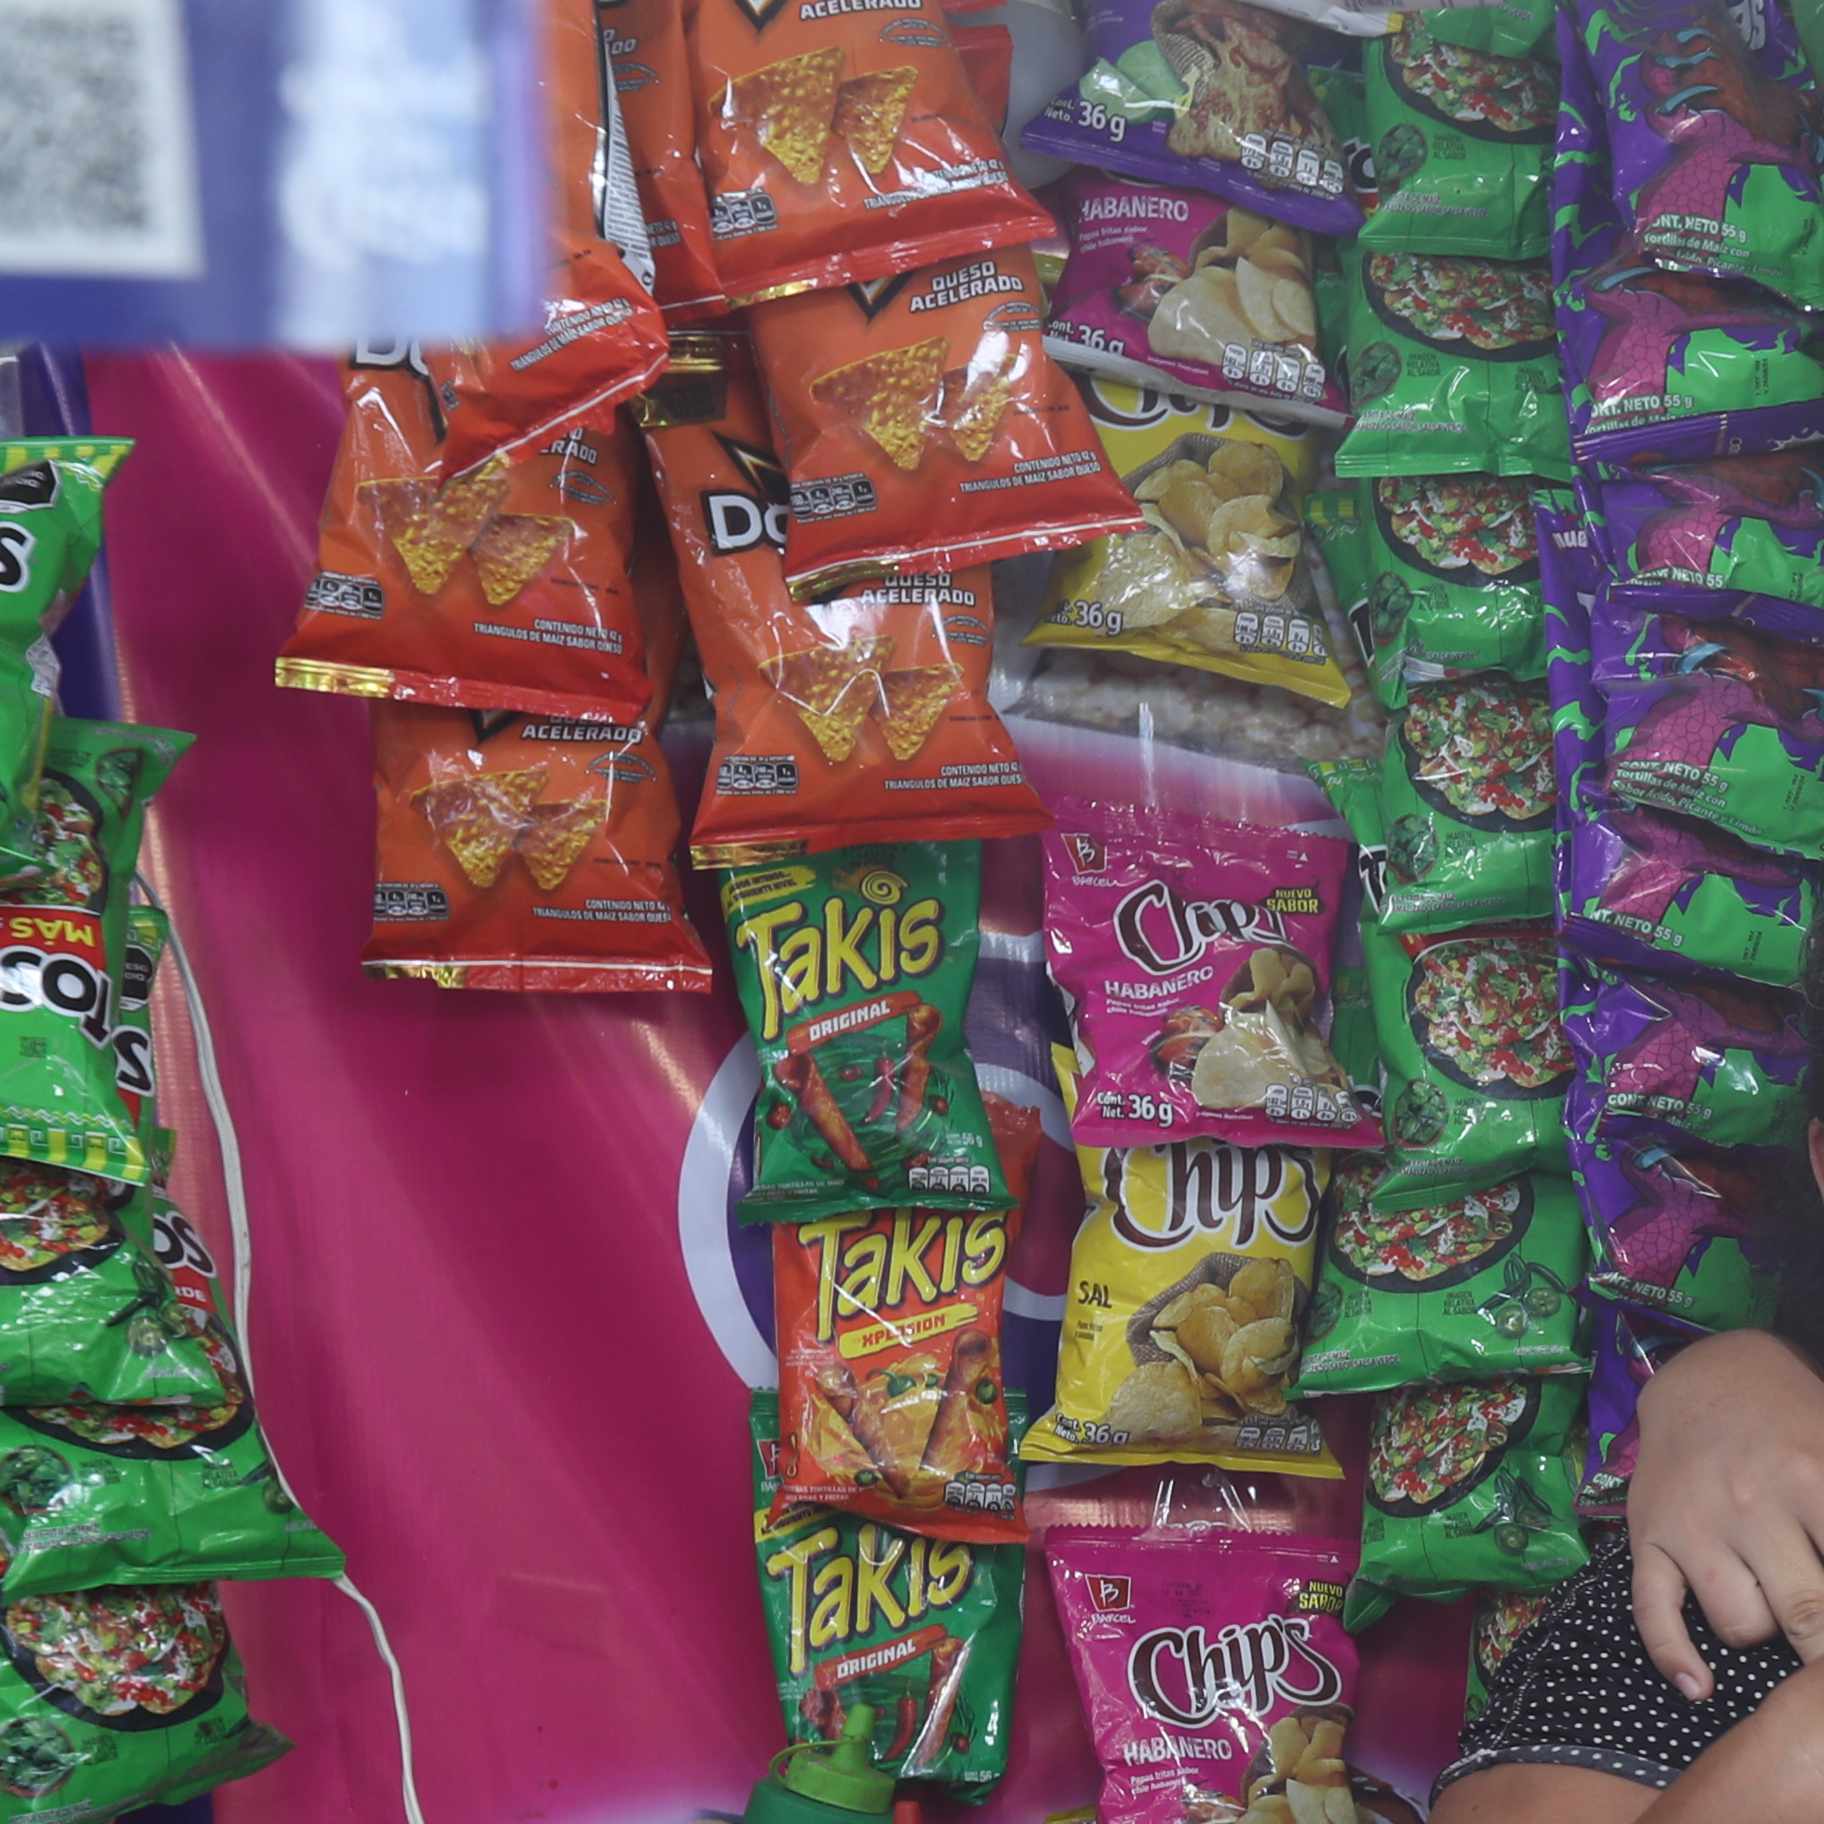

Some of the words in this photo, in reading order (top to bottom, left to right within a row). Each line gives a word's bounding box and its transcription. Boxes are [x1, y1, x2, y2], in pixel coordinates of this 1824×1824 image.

[1078, 100, 1106, 131] 36
[1110, 114, 1127, 143] g
[1685, 218, 1720, 235] NETO
[1721, 222, 1736, 239] 55
[1738, 229, 1747, 245] g
[1687, 234, 1702, 249] de
[1731, 245, 1751, 259] con
[931, 261, 996, 290] QUESO
[909, 274, 1023, 313] ACELERADO
[1078, 325, 1106, 350] 36
[1623, 394, 1660, 414] NETO
[1663, 392, 1681, 408] 55
[1684, 394, 1693, 409] g
[1013, 456, 1061, 473] CONTENIDO
[1061, 452, 1081, 465] NETO
[959, 477, 1012, 492] TRIÁNGULOS
[1012, 475, 1023, 486] DE
[1024, 471, 1047, 485] MAÍZ
[1047, 467, 1076, 481] SABOR
[1076, 461, 1101, 475] QUESO
[1671, 566, 1703, 585] NETO
[1706, 572, 1724, 588] 55
[862, 588, 976, 606] ACELERADO
[534, 617, 584, 635] CONTENIDO
[1074, 600, 1103, 628] 36
[1105, 608, 1124, 636] g
[474, 621, 528, 640] TRIÁNGULOS
[529, 629, 542, 642] DE
[541, 630, 566, 646] MAÍZ
[565, 635, 597, 650] SABOR
[522, 725, 642, 743] ACELERADO
[941, 764, 987, 777] CONTENIDO
[989, 762, 1009, 773] NETO
[1662, 761, 1701, 782] NETO
[1701, 769, 1720, 788] 55
[1719, 780, 1730, 794] g
[885, 778, 935, 790] TRIÁNGULOS
[937, 777, 948, 789] DE
[949, 776, 971, 788] MAÍZ
[972, 775, 999, 787] SABOR
[1616, 767, 1663, 787] Tortillas
[1664, 778, 1678, 790] de
[1706, 792, 1727, 809] con
[1611, 779, 1646, 798] Sabor
[1677, 796, 1722, 821] Picante
[586, 898, 631, 911] CONTENIDO
[633, 900, 655, 911] NETO
[1266, 899, 1320, 914] SABOR
[1275, 889, 1313, 899] NUEVO
[533, 906, 583, 919] TRIÁNGULOS
[584, 910, 594, 920] DE
[618, 911, 646, 923] SABOR
[9, 916, 96, 947] MÁS
[1613, 913, 1652, 934] NETO
[1653, 925, 1673, 942] 55
[1673, 933, 1683, 947] g
[736, 898, 940, 1040] Takis
[1104, 965, 1215, 1000] HABANERO
[809, 1000, 891, 1041] ORIGINAL
[1096, 1092, 1126, 1106] Cont.
[1127, 1093, 1156, 1121] 36
[1157, 1101, 1174, 1128] g
[1648, 1095, 1685, 1111] NETO
[1686, 1102, 1702, 1115] 55
[1102, 1106, 1125, 1120] Net.
[962, 1131, 975, 1148] 56
[798, 1208, 1006, 1341] Takis
[1077, 1280, 1113, 1309] SAL
[1631, 1281, 1667, 1300] NETO
[1667, 1288, 1684, 1304] 55
[1082, 1422, 1111, 1445] 36
[766, 1523, 973, 1677] Takis
[1309, 1580, 1344, 1598] NUEVO
[1092, 1612, 1137, 1625] BARCEL
[836, 1638, 917, 1680] ORIGINAL
[1124, 1738, 1233, 1767] HABANERO
